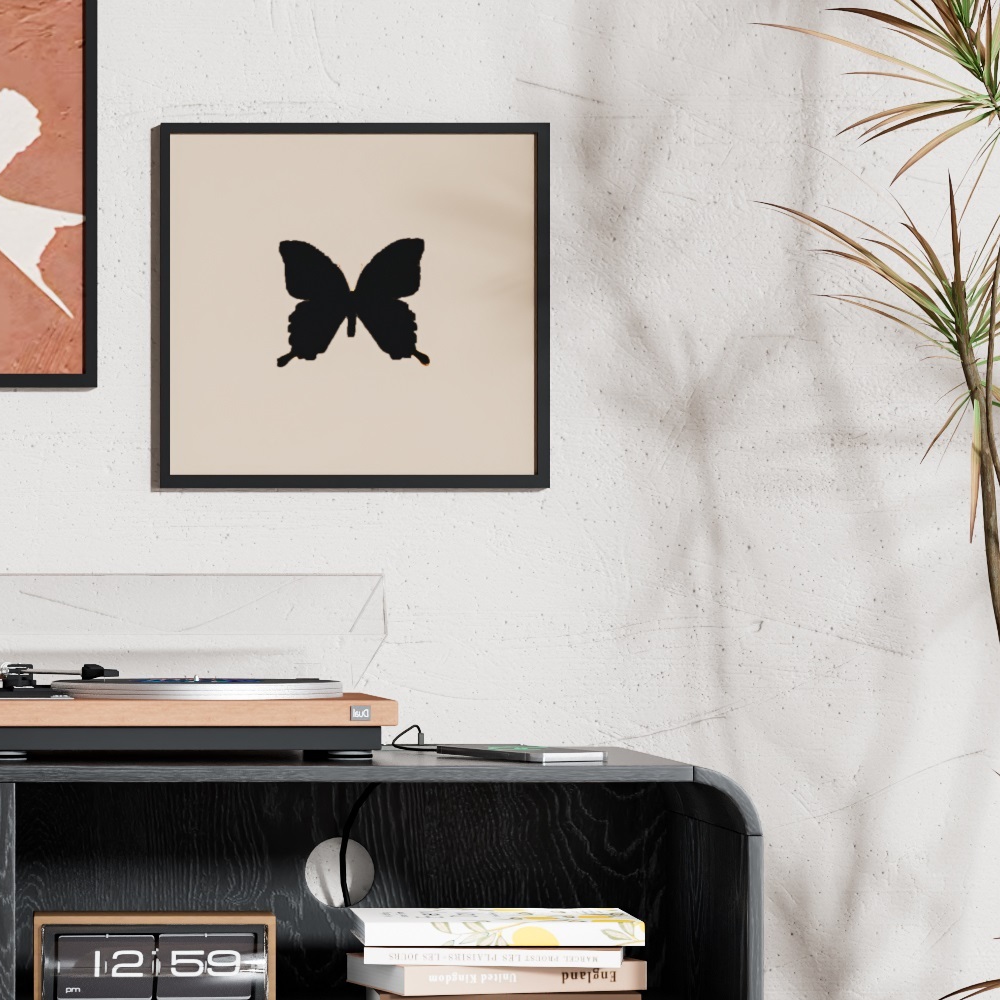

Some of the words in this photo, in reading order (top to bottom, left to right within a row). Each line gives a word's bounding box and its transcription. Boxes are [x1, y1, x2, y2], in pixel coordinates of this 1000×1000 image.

[428, 972, 477, 984] Kingdom
[480, 973, 517, 984] United
[560, 969, 617, 984] England
[65, 986, 81, 994] pm
